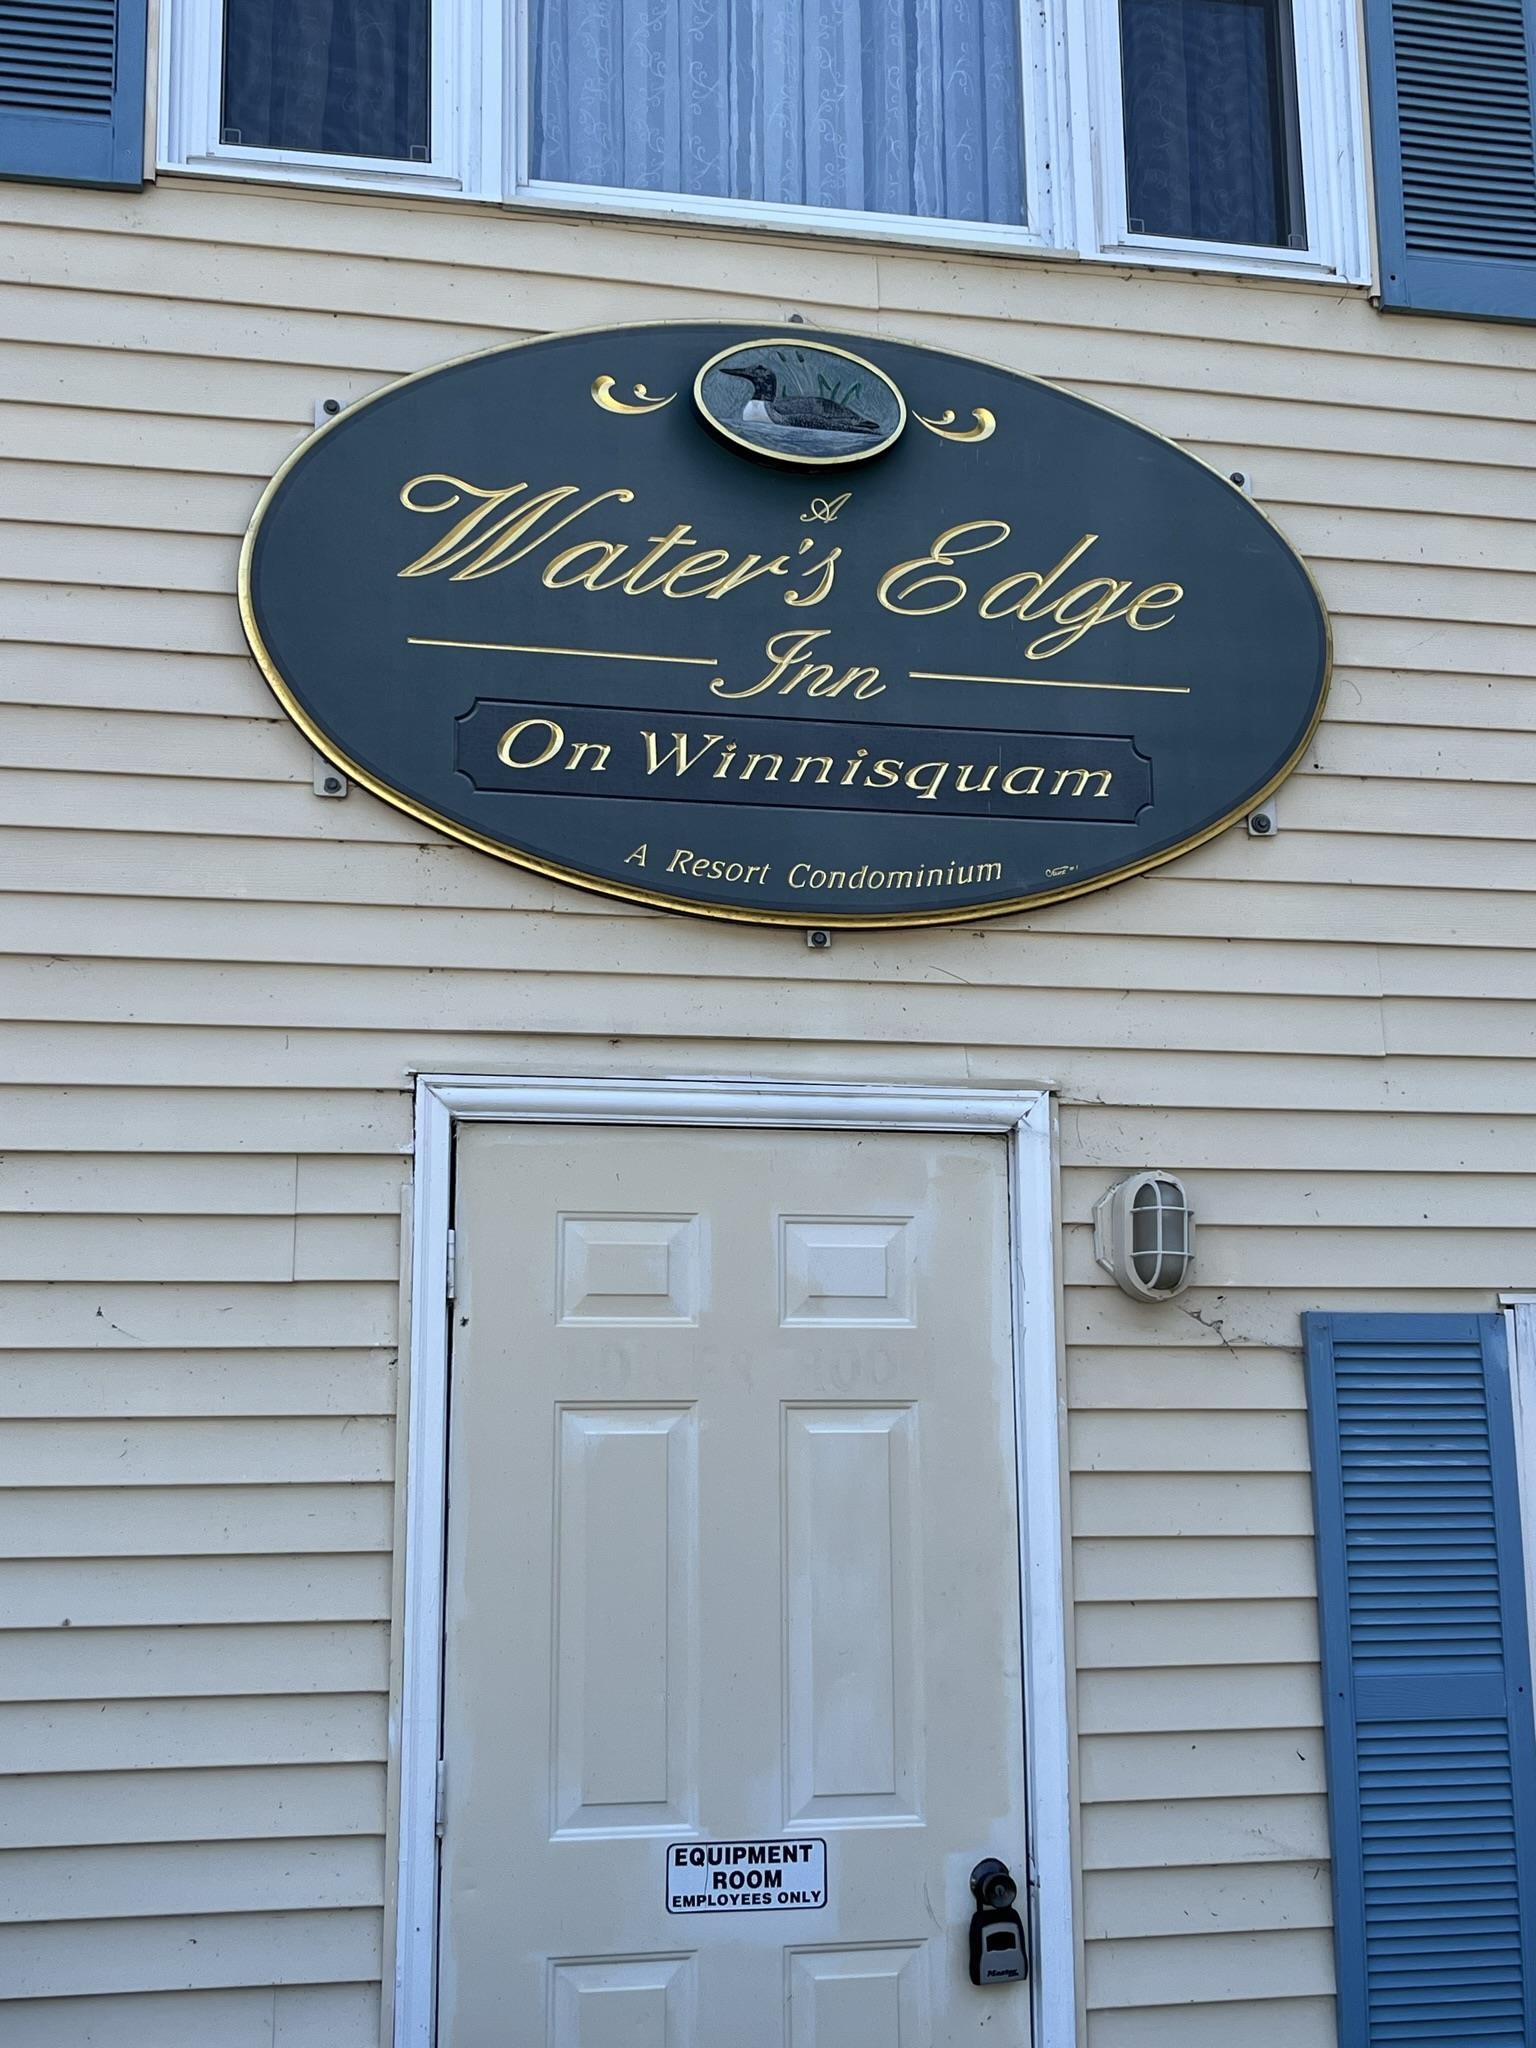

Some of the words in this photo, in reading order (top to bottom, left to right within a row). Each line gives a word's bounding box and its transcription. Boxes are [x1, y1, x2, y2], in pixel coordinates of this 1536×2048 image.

[800, 492, 852, 523] A
[397, 474, 842, 607] Water's
[877, 519, 1184, 660] Edge
[709, 629, 887, 699] Inn
[497, 718, 612, 771] On
[639, 729, 1113, 800] Winnisquam
[624, 843, 648, 868] A
[666, 849, 772, 885] Resort
[787, 860, 1002, 889] Condominium
[674, 1845, 813, 1867] EQUIPMENT
[712, 1869, 783, 1890] ROOM
[672, 1892, 772, 1908] EMPLOYEES
[777, 1891, 821, 1904] ONLY
